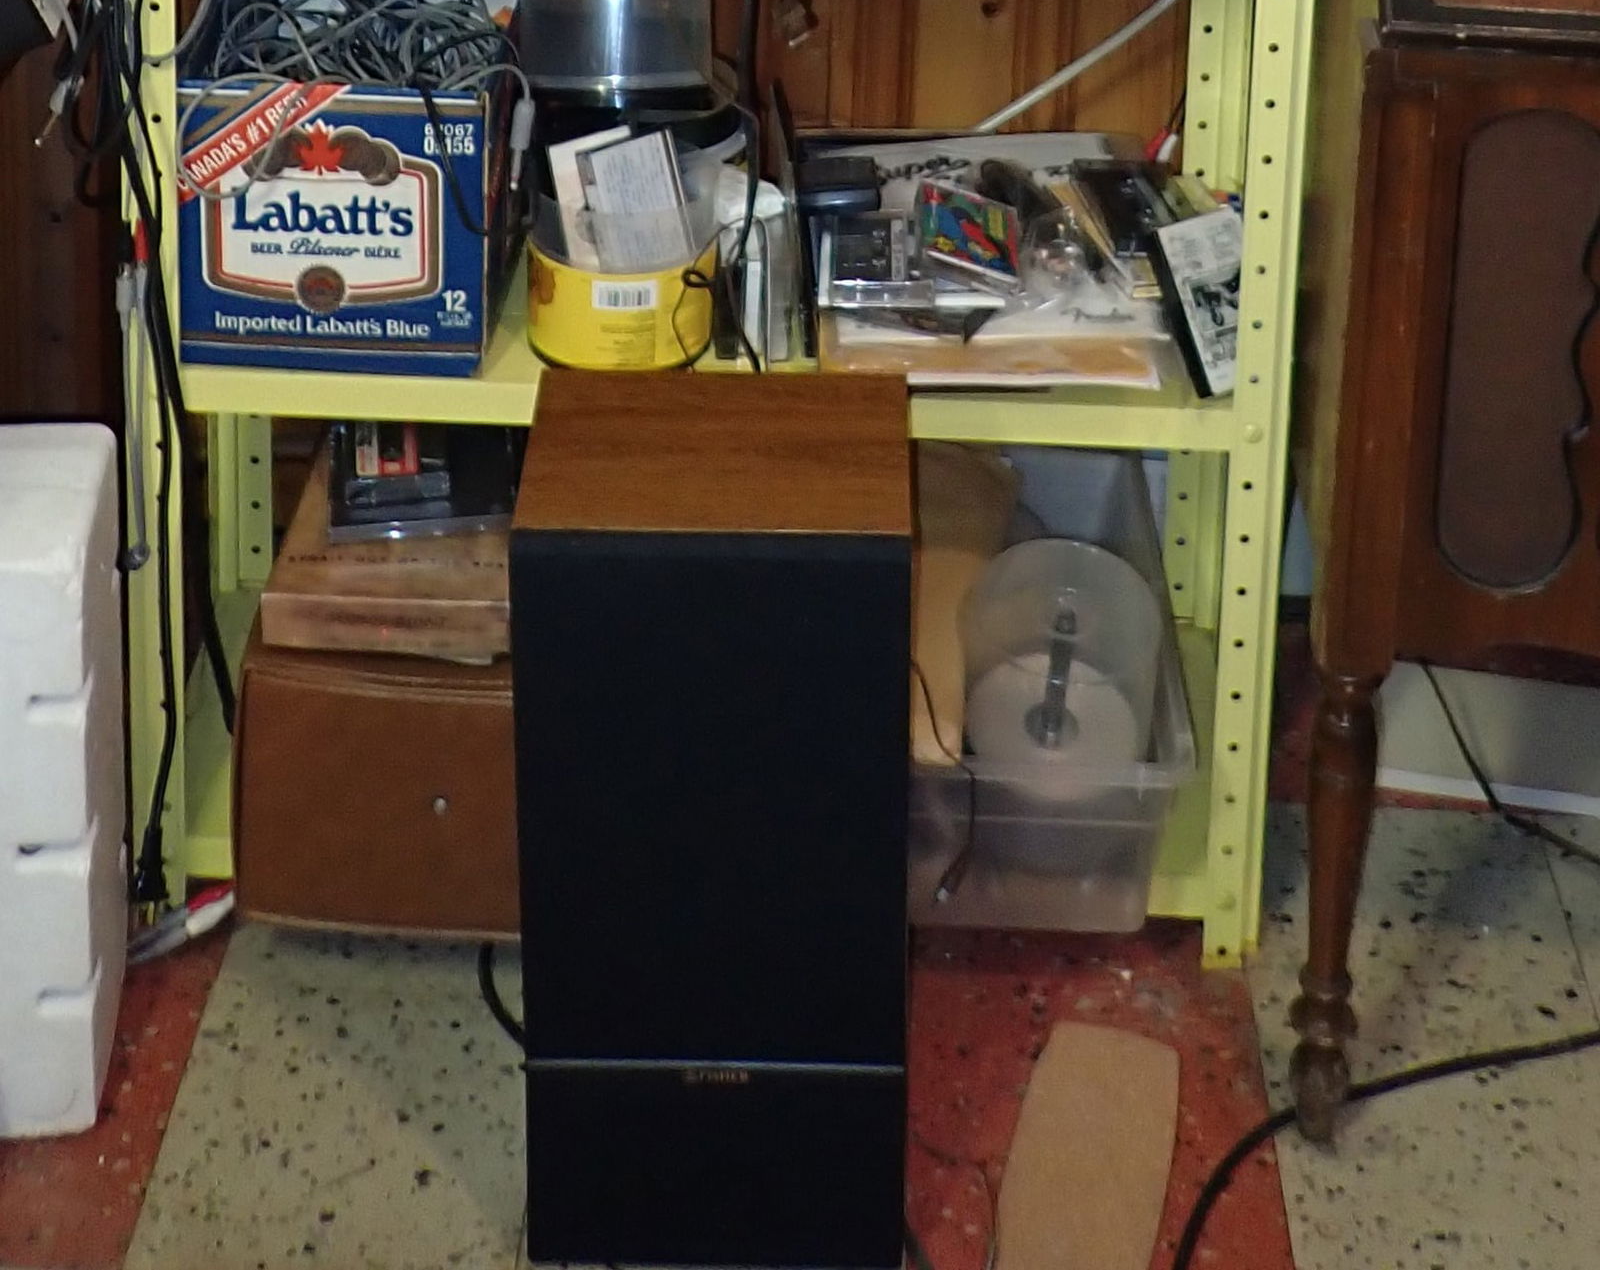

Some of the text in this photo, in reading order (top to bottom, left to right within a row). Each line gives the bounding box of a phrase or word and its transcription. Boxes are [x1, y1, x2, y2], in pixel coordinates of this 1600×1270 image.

[246, 116, 271, 145] #1
[424, 122, 474, 136] 6067
[231, 190, 414, 237] Labatt's
[251, 241, 283, 254] BEER
[286, 237, 361, 257] Pilsener
[441, 290, 468, 312] 12
[214, 311, 301, 335] Imported
[306, 315, 383, 337] Labatt's
[386, 318, 432, 338] Blue
